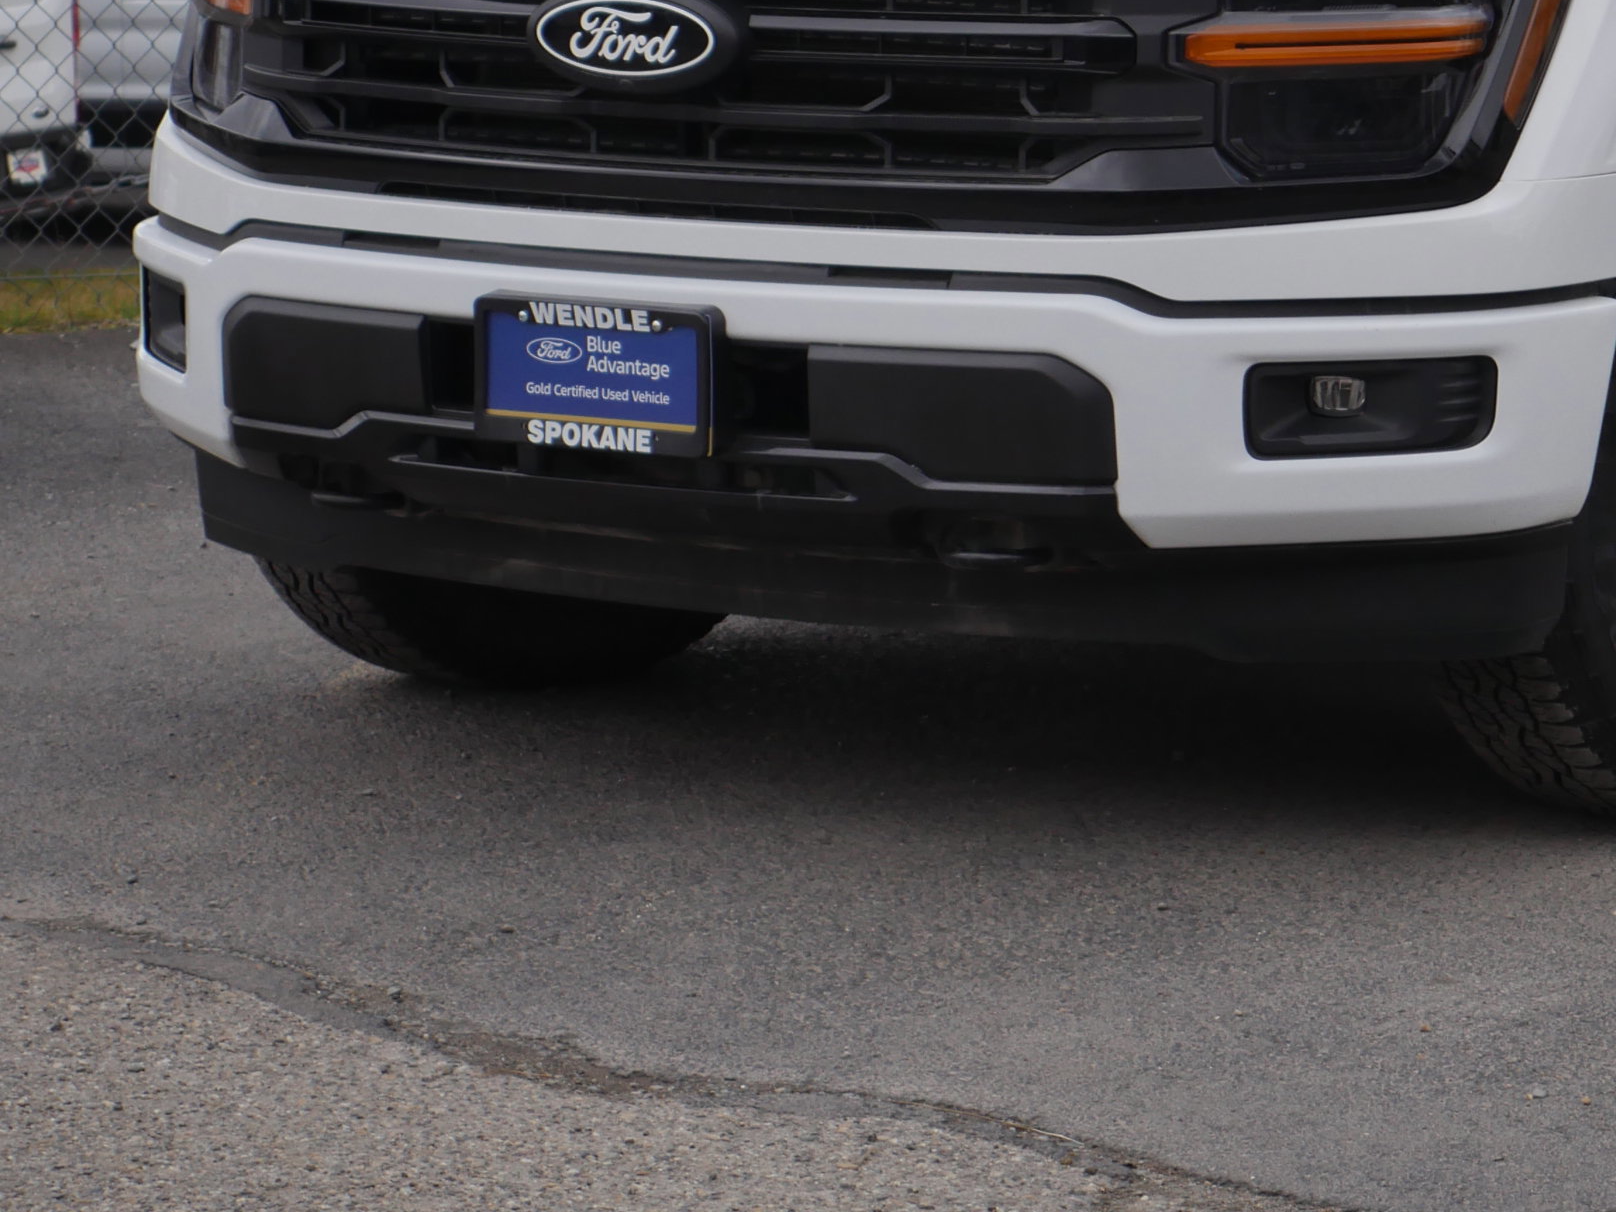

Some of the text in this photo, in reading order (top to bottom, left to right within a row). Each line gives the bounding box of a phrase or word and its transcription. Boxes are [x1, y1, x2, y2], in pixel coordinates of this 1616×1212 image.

[569, 6, 680, 64] Ford
[529, 301, 651, 333] WENDLE
[536, 339, 572, 361] Ford
[586, 335, 622, 355] Blue
[586, 355, 670, 380] Advantage
[526, 381, 670, 405] Gold Certified Used Vehicle
[527, 419, 653, 454] SPOKANE
